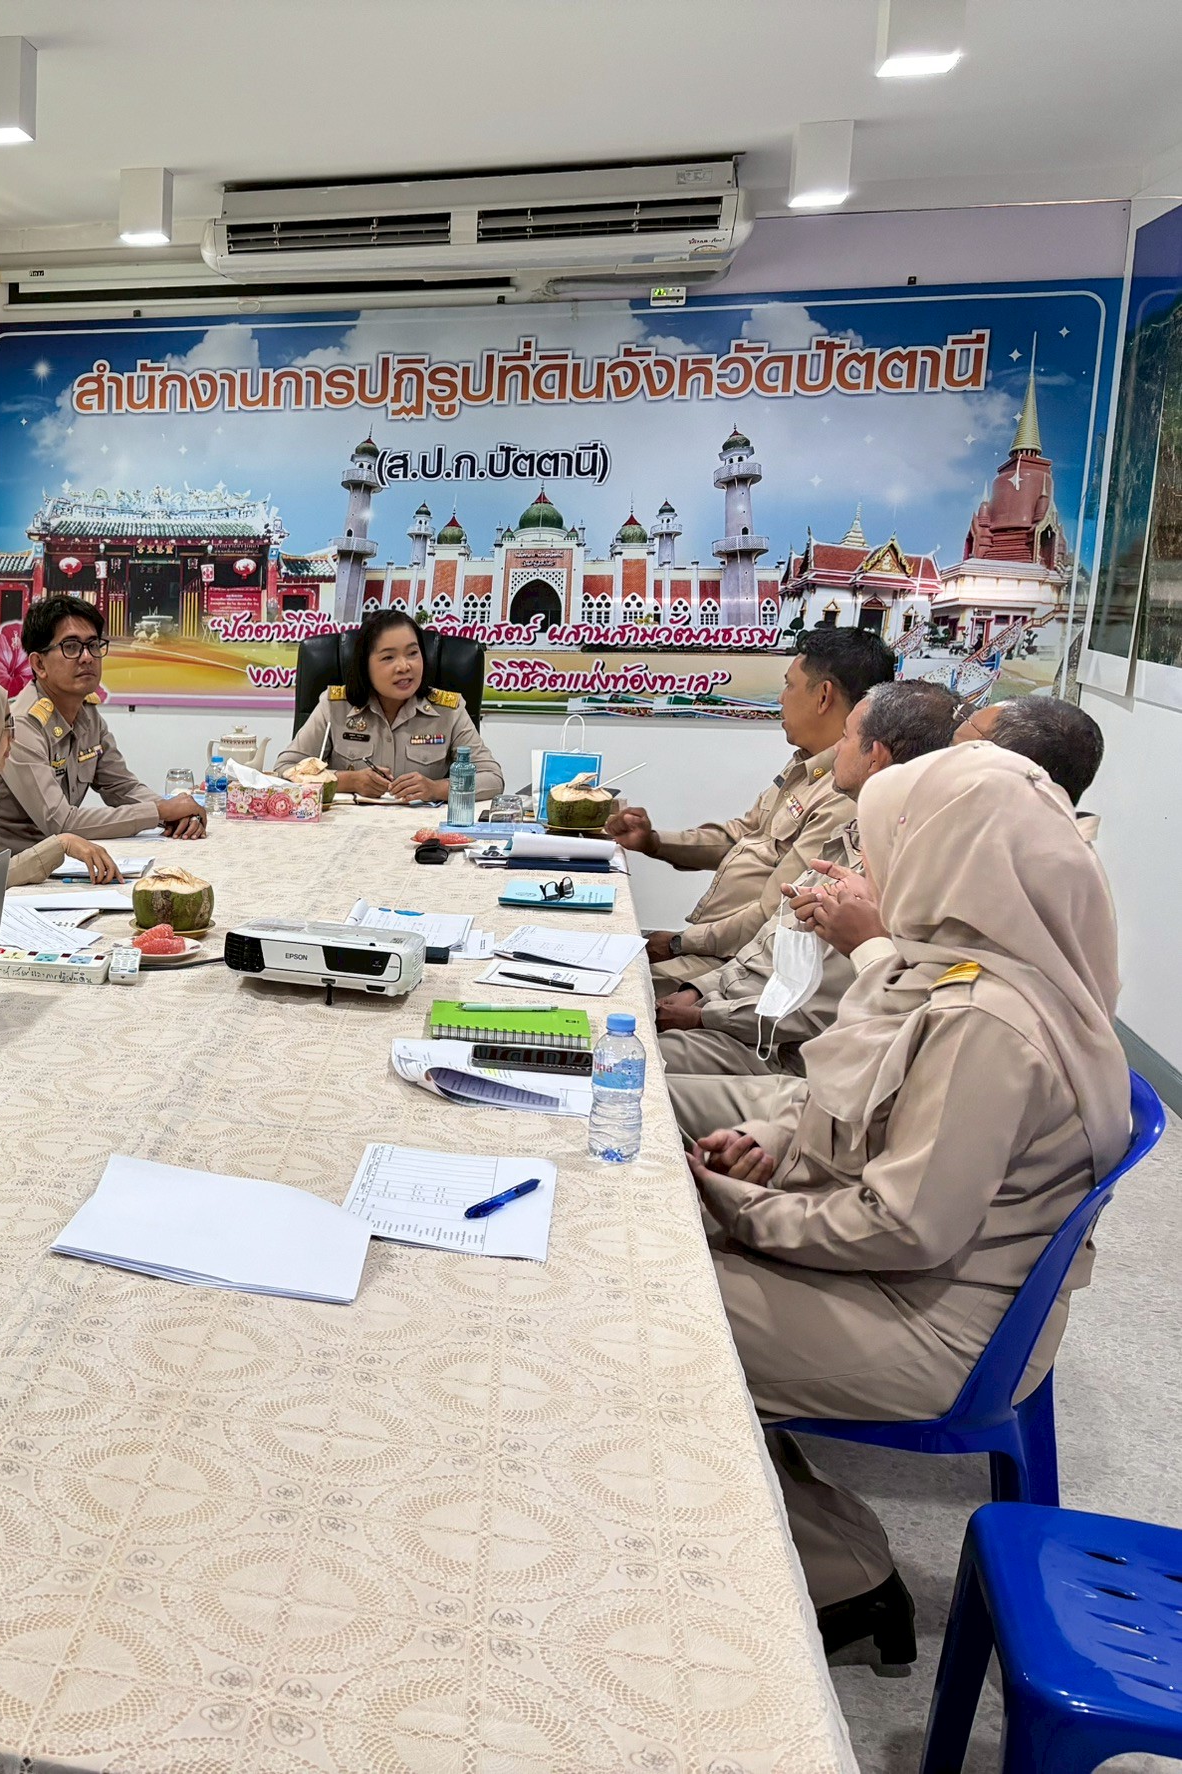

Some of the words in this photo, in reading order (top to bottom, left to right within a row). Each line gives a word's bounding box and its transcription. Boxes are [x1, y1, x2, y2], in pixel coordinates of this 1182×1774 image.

[74, 331, 988, 419] สำนักงานการปฏิรูปที่ดินจังหวัดปัตตานี
[376, 441, 609, 486] (ส.ป.ก.ปัตตานี)
[285, 952, 308, 961] EPSON
